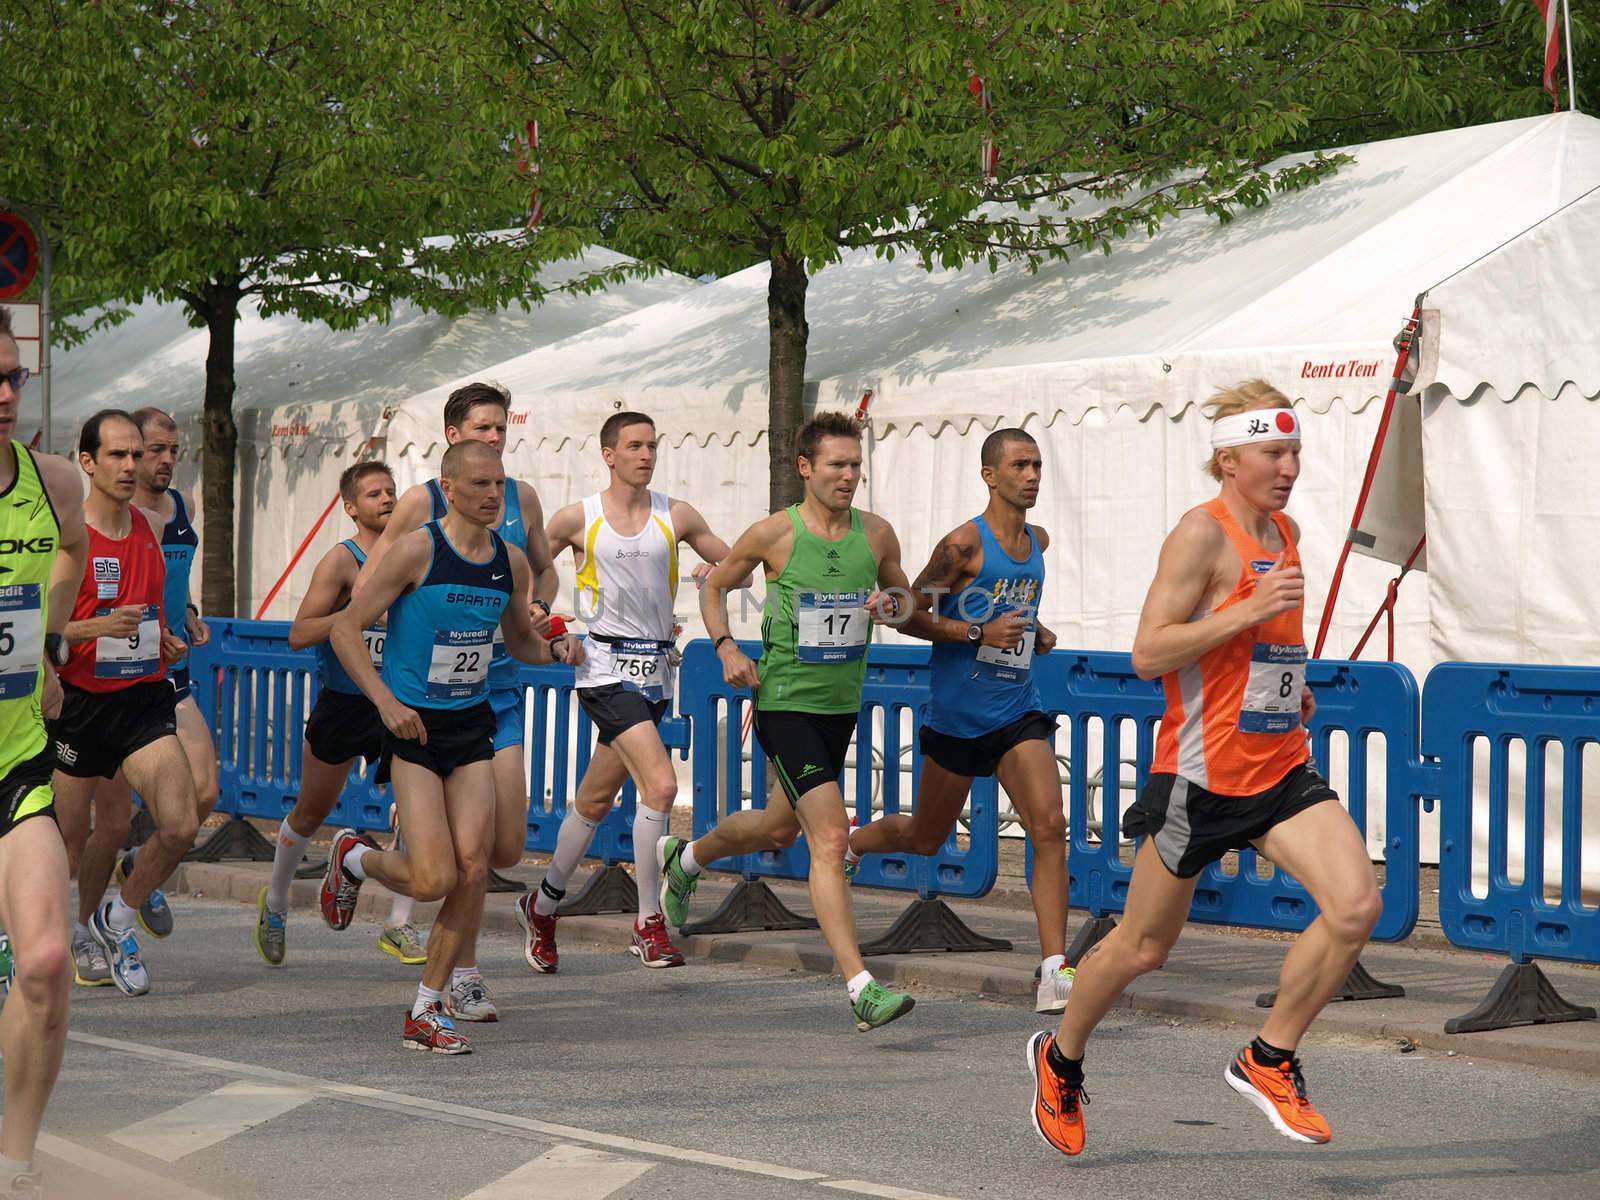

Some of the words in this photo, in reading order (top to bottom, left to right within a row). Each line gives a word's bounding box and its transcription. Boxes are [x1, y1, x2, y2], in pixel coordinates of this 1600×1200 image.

[1301, 361, 1335, 379] Rent
[1336, 366, 1346, 377] a
[1348, 360, 1379, 377] Tent
[446, 592, 502, 608] SPARTA
[450, 630, 489, 639] Nykredit
[824, 614, 851, 635] 17
[454, 651, 481, 673] 22
[1279, 671, 1294, 698] 8
